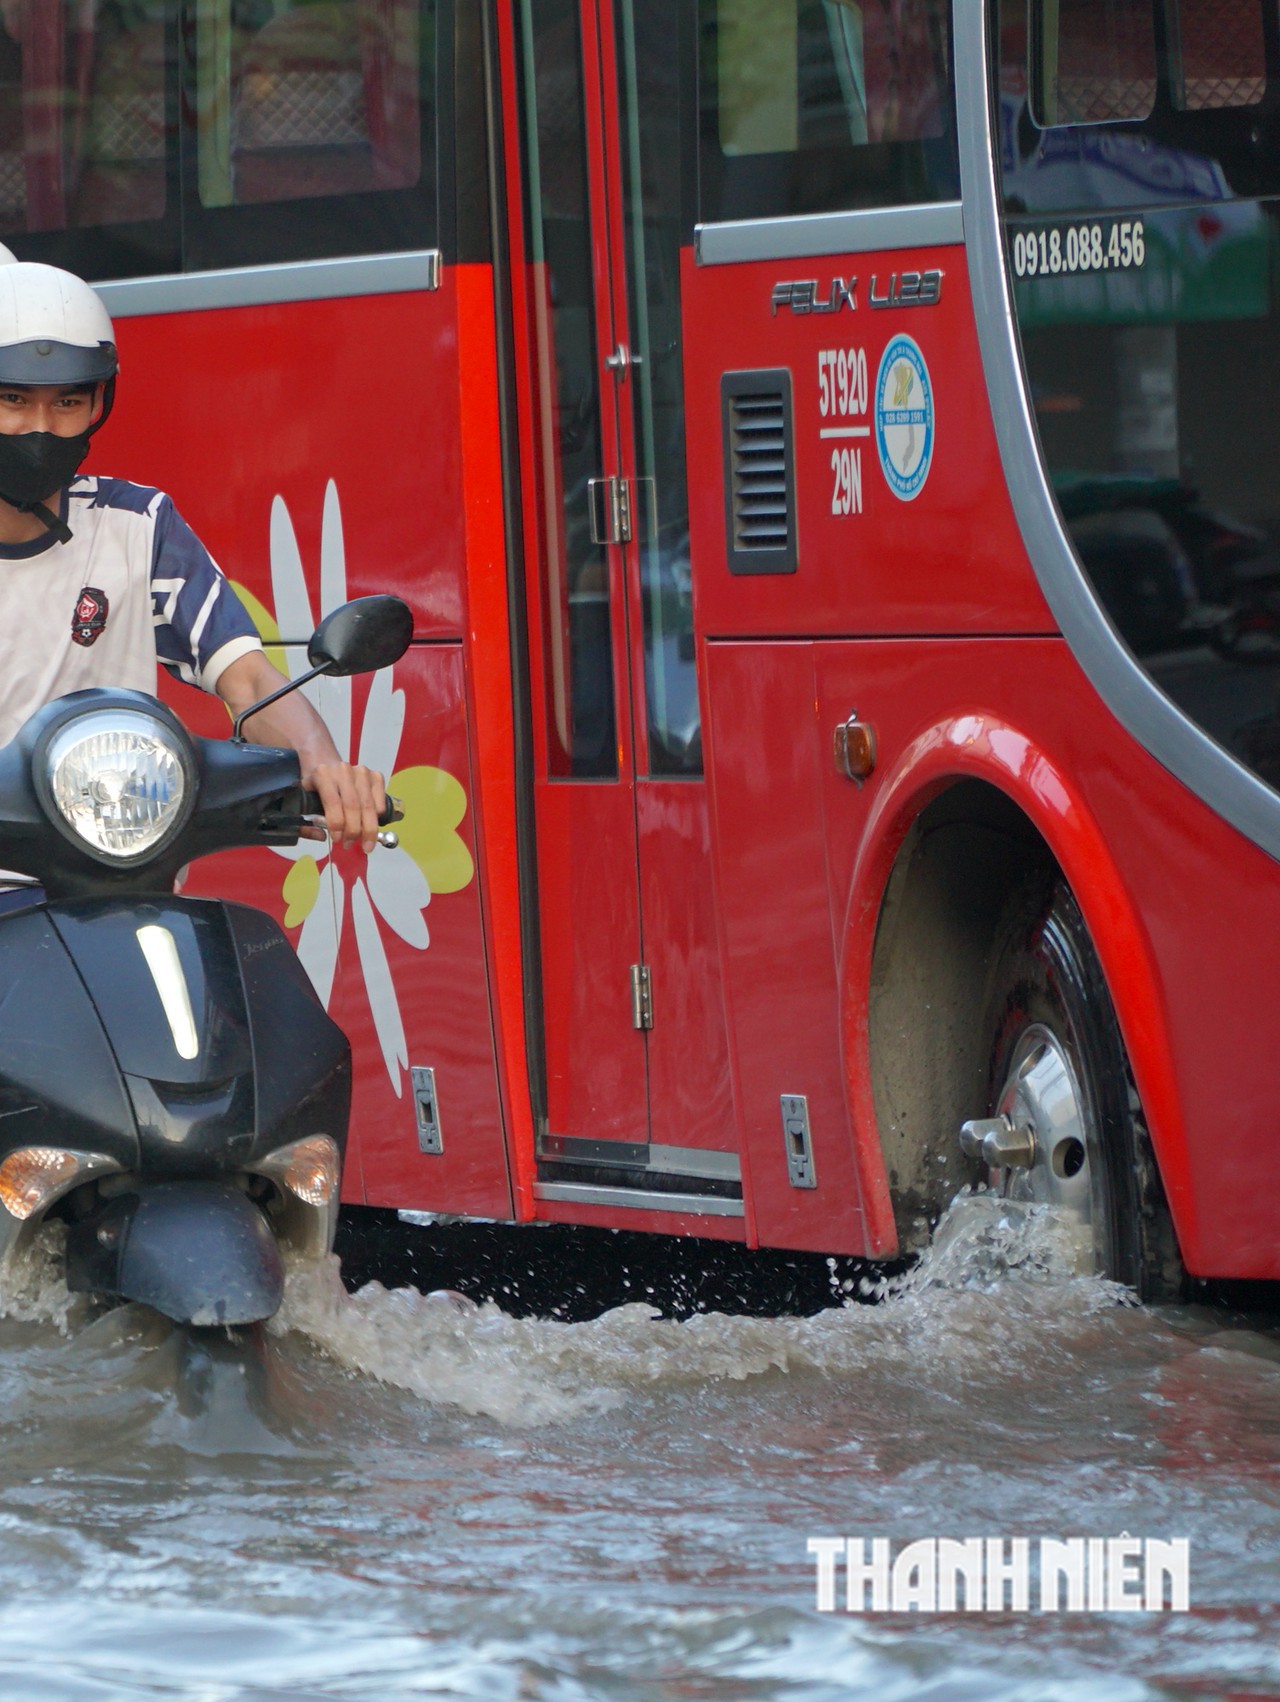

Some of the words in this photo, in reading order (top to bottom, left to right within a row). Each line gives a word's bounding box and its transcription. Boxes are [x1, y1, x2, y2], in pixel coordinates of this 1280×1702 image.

[1014, 221, 1144, 277] 0918.088.456
[771, 275, 857, 316] FELIX
[819, 347, 868, 415] 5T920
[832, 448, 862, 515] 29N
